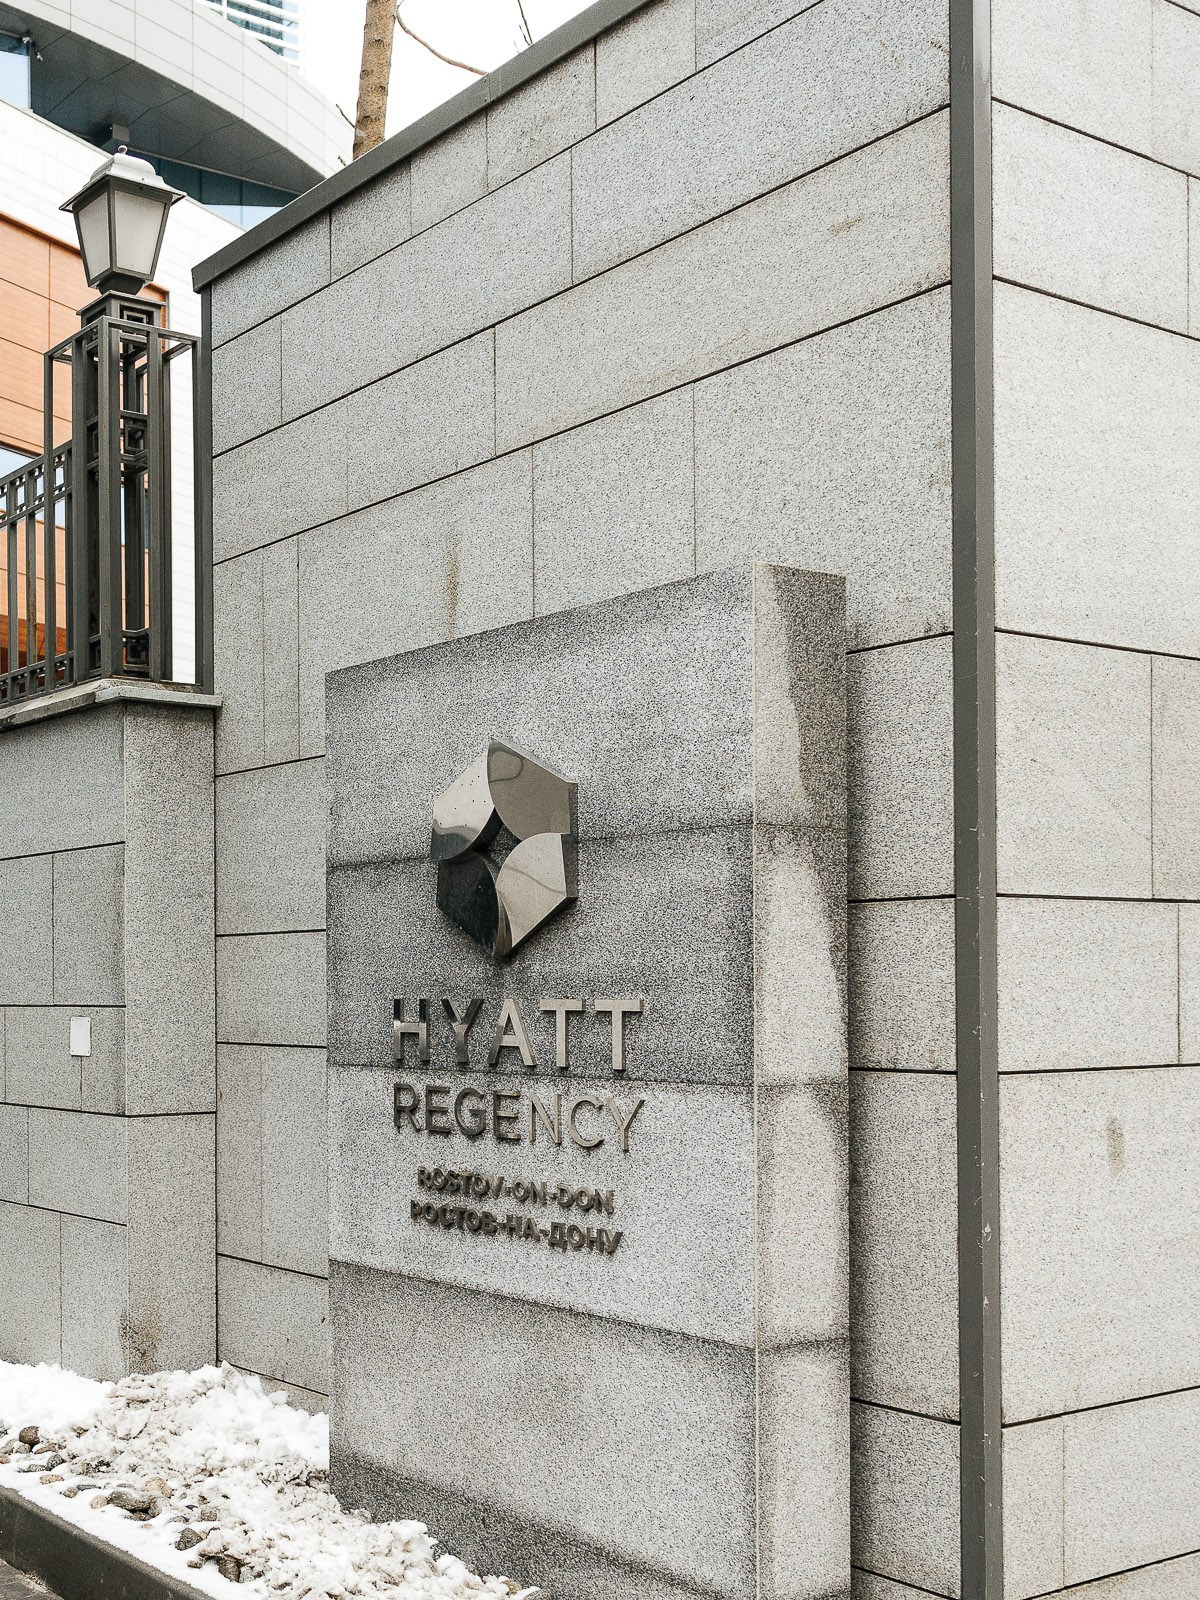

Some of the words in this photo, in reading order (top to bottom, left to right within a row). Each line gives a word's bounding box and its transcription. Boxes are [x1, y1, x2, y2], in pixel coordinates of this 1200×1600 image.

[393, 998, 644, 1070] HYATT
[393, 1082, 645, 1150] REGENCY
[417, 1165, 615, 1214] ROSTOV-ON-DON
[410, 1199, 624, 1254] РОСТОВ-НА-ДОНУ
